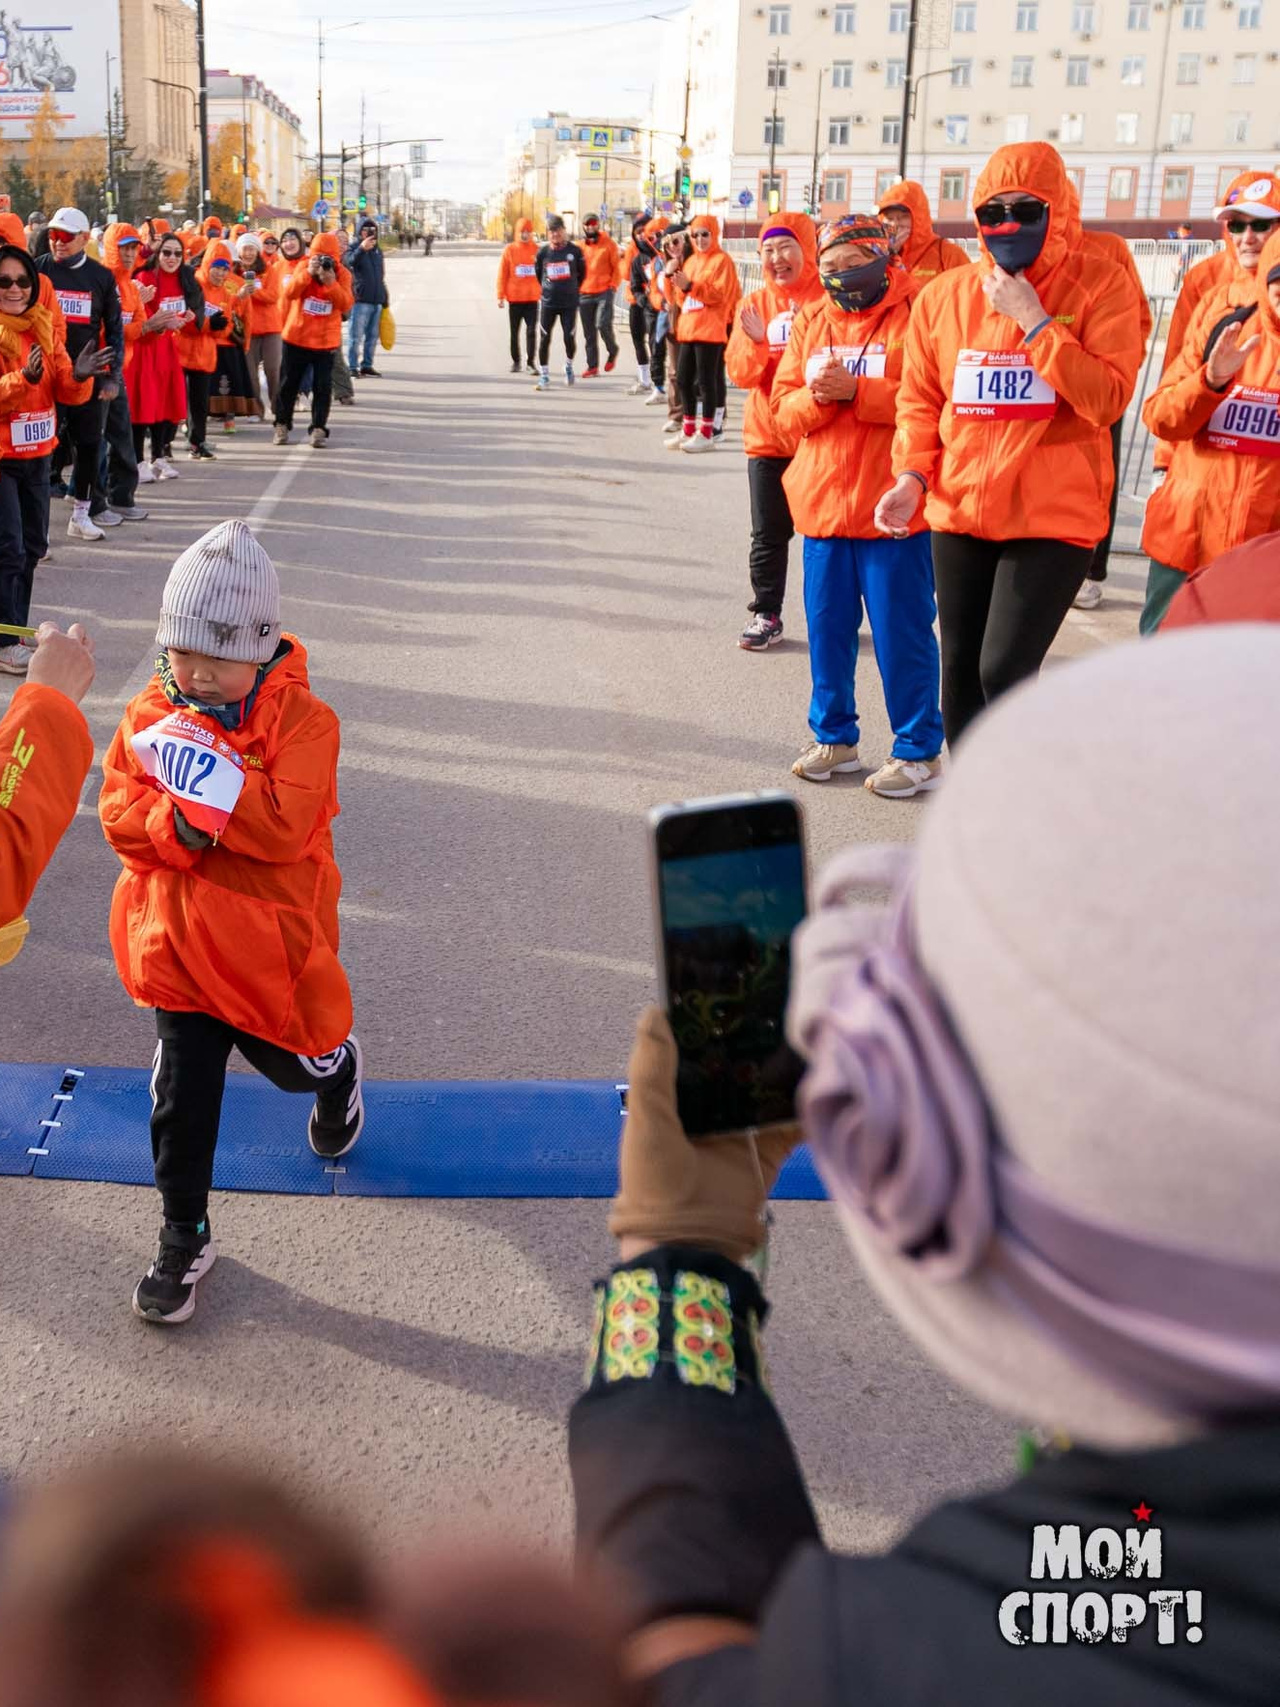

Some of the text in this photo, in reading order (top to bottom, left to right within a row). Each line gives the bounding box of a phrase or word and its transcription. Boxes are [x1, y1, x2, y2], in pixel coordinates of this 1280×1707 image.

[976, 370, 1033, 399] 1482
[956, 406, 995, 415] ЯКУТСК
[1223, 402, 1280, 437] 0996
[24, 420, 51, 442] 0982
[150, 739, 217, 797] 1002
